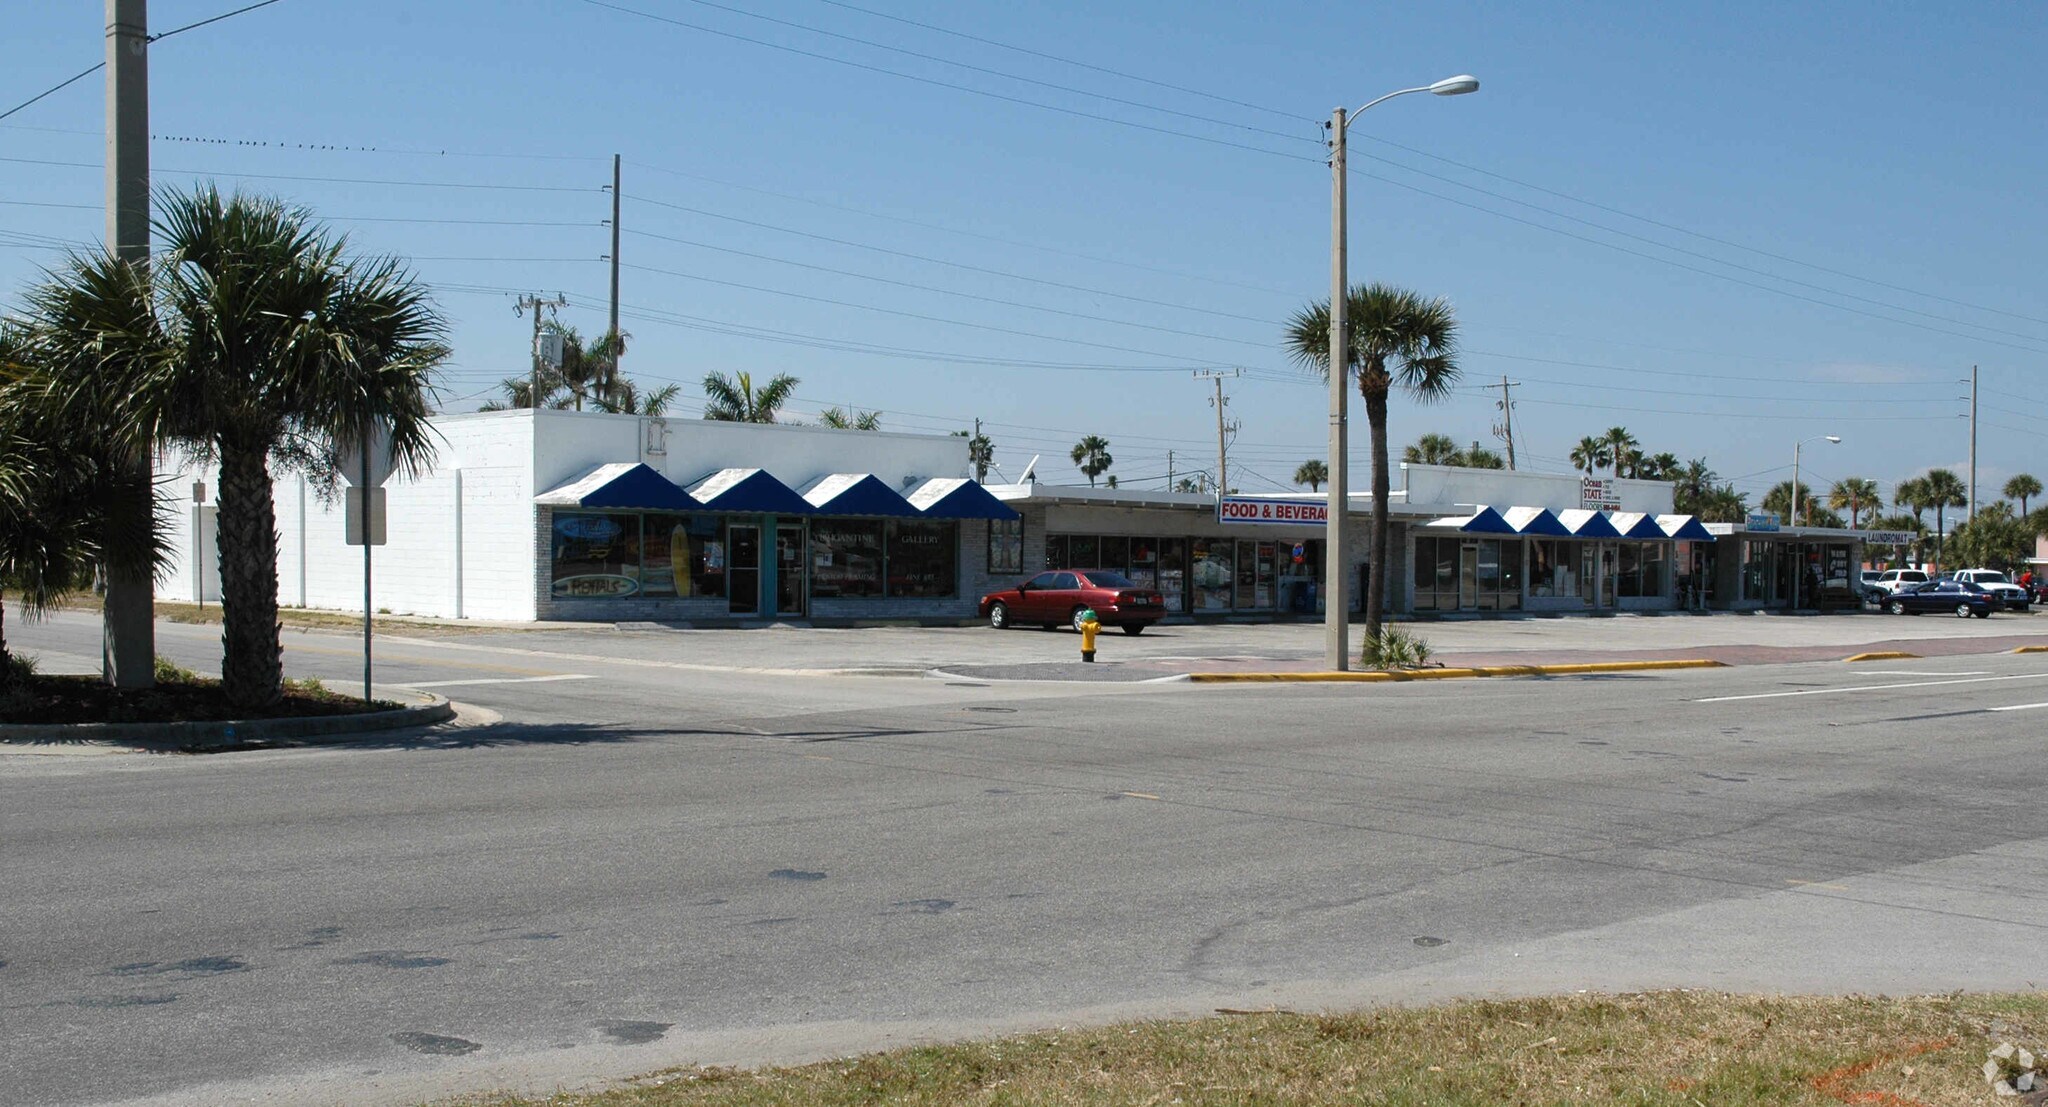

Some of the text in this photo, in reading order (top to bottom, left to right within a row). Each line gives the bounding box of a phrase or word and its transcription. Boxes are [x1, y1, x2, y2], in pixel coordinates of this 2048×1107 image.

[1584, 488, 1602, 499] STATE
[1222, 503, 1328, 520] FOOD & BEVERA
[901, 535, 939, 544] GALLERY
[1868, 532, 1908, 543] LAUNDROMAT
